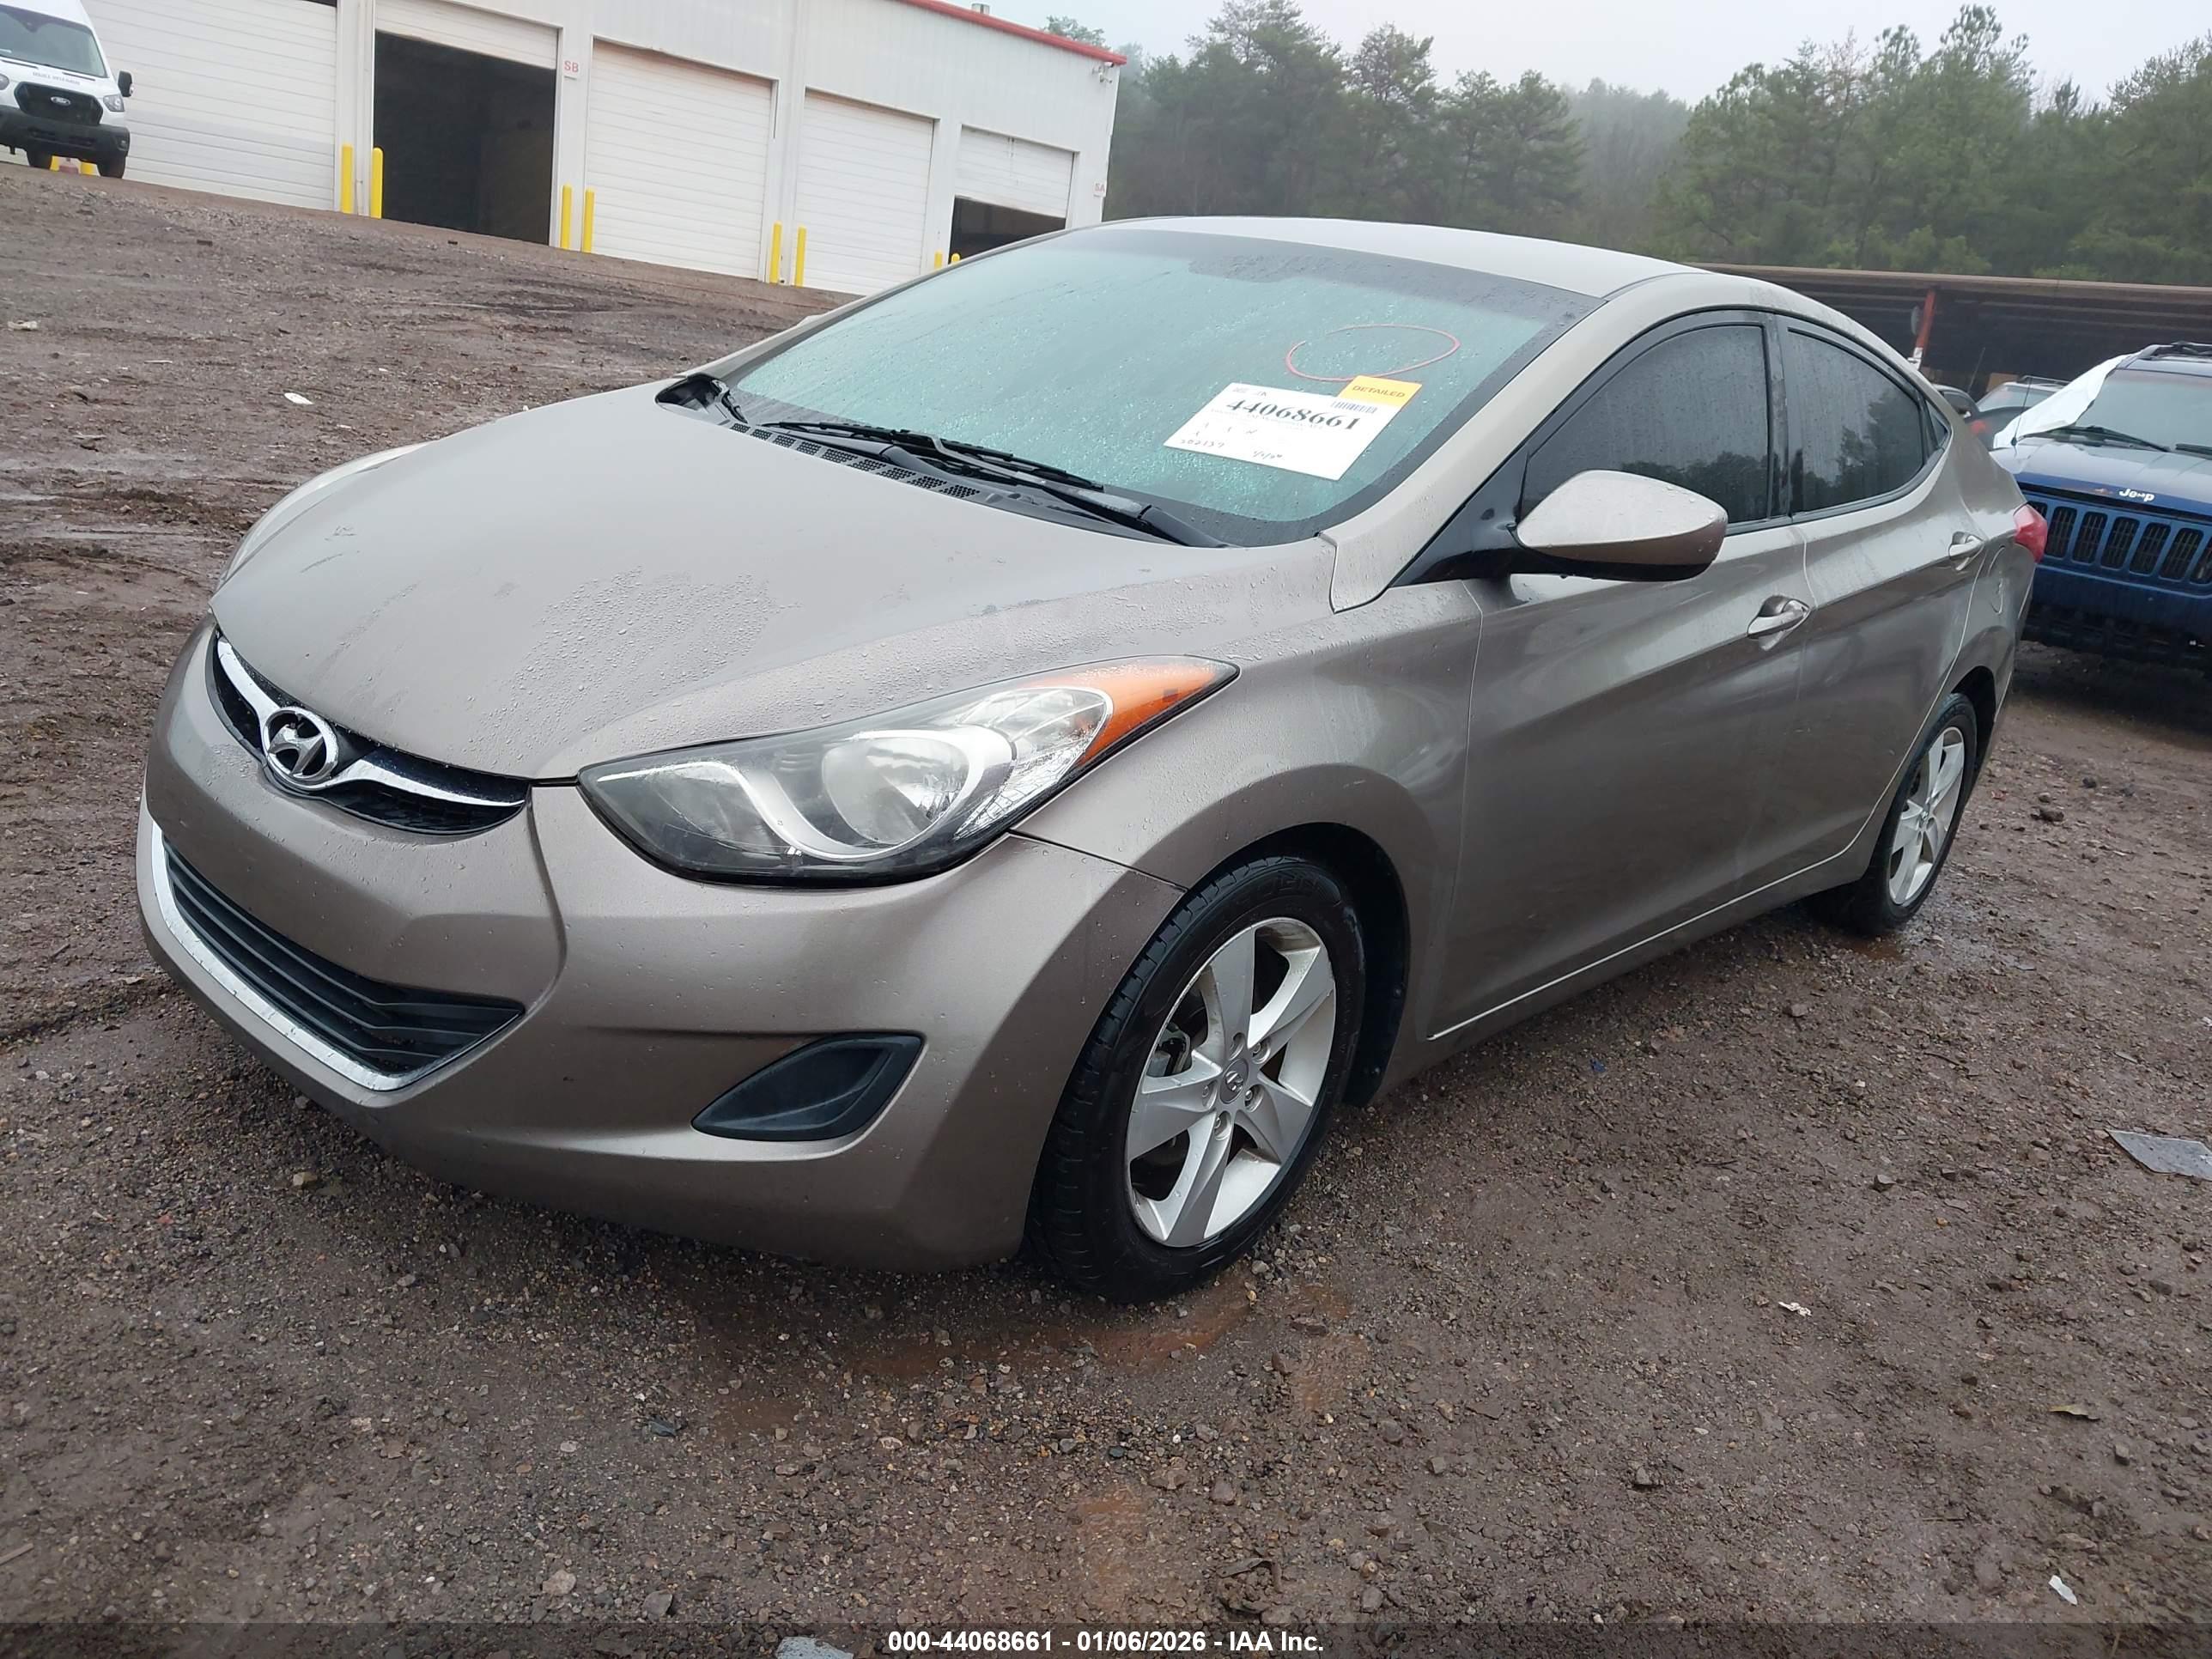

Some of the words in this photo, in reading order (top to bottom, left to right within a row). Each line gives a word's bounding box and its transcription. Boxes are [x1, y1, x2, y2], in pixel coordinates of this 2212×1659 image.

[563, 60, 579, 73] SB
[1352, 385, 1406, 398] DETAILED
[1226, 398, 1361, 430] 44068661
[2118, 488, 2155, 502] Jeep
